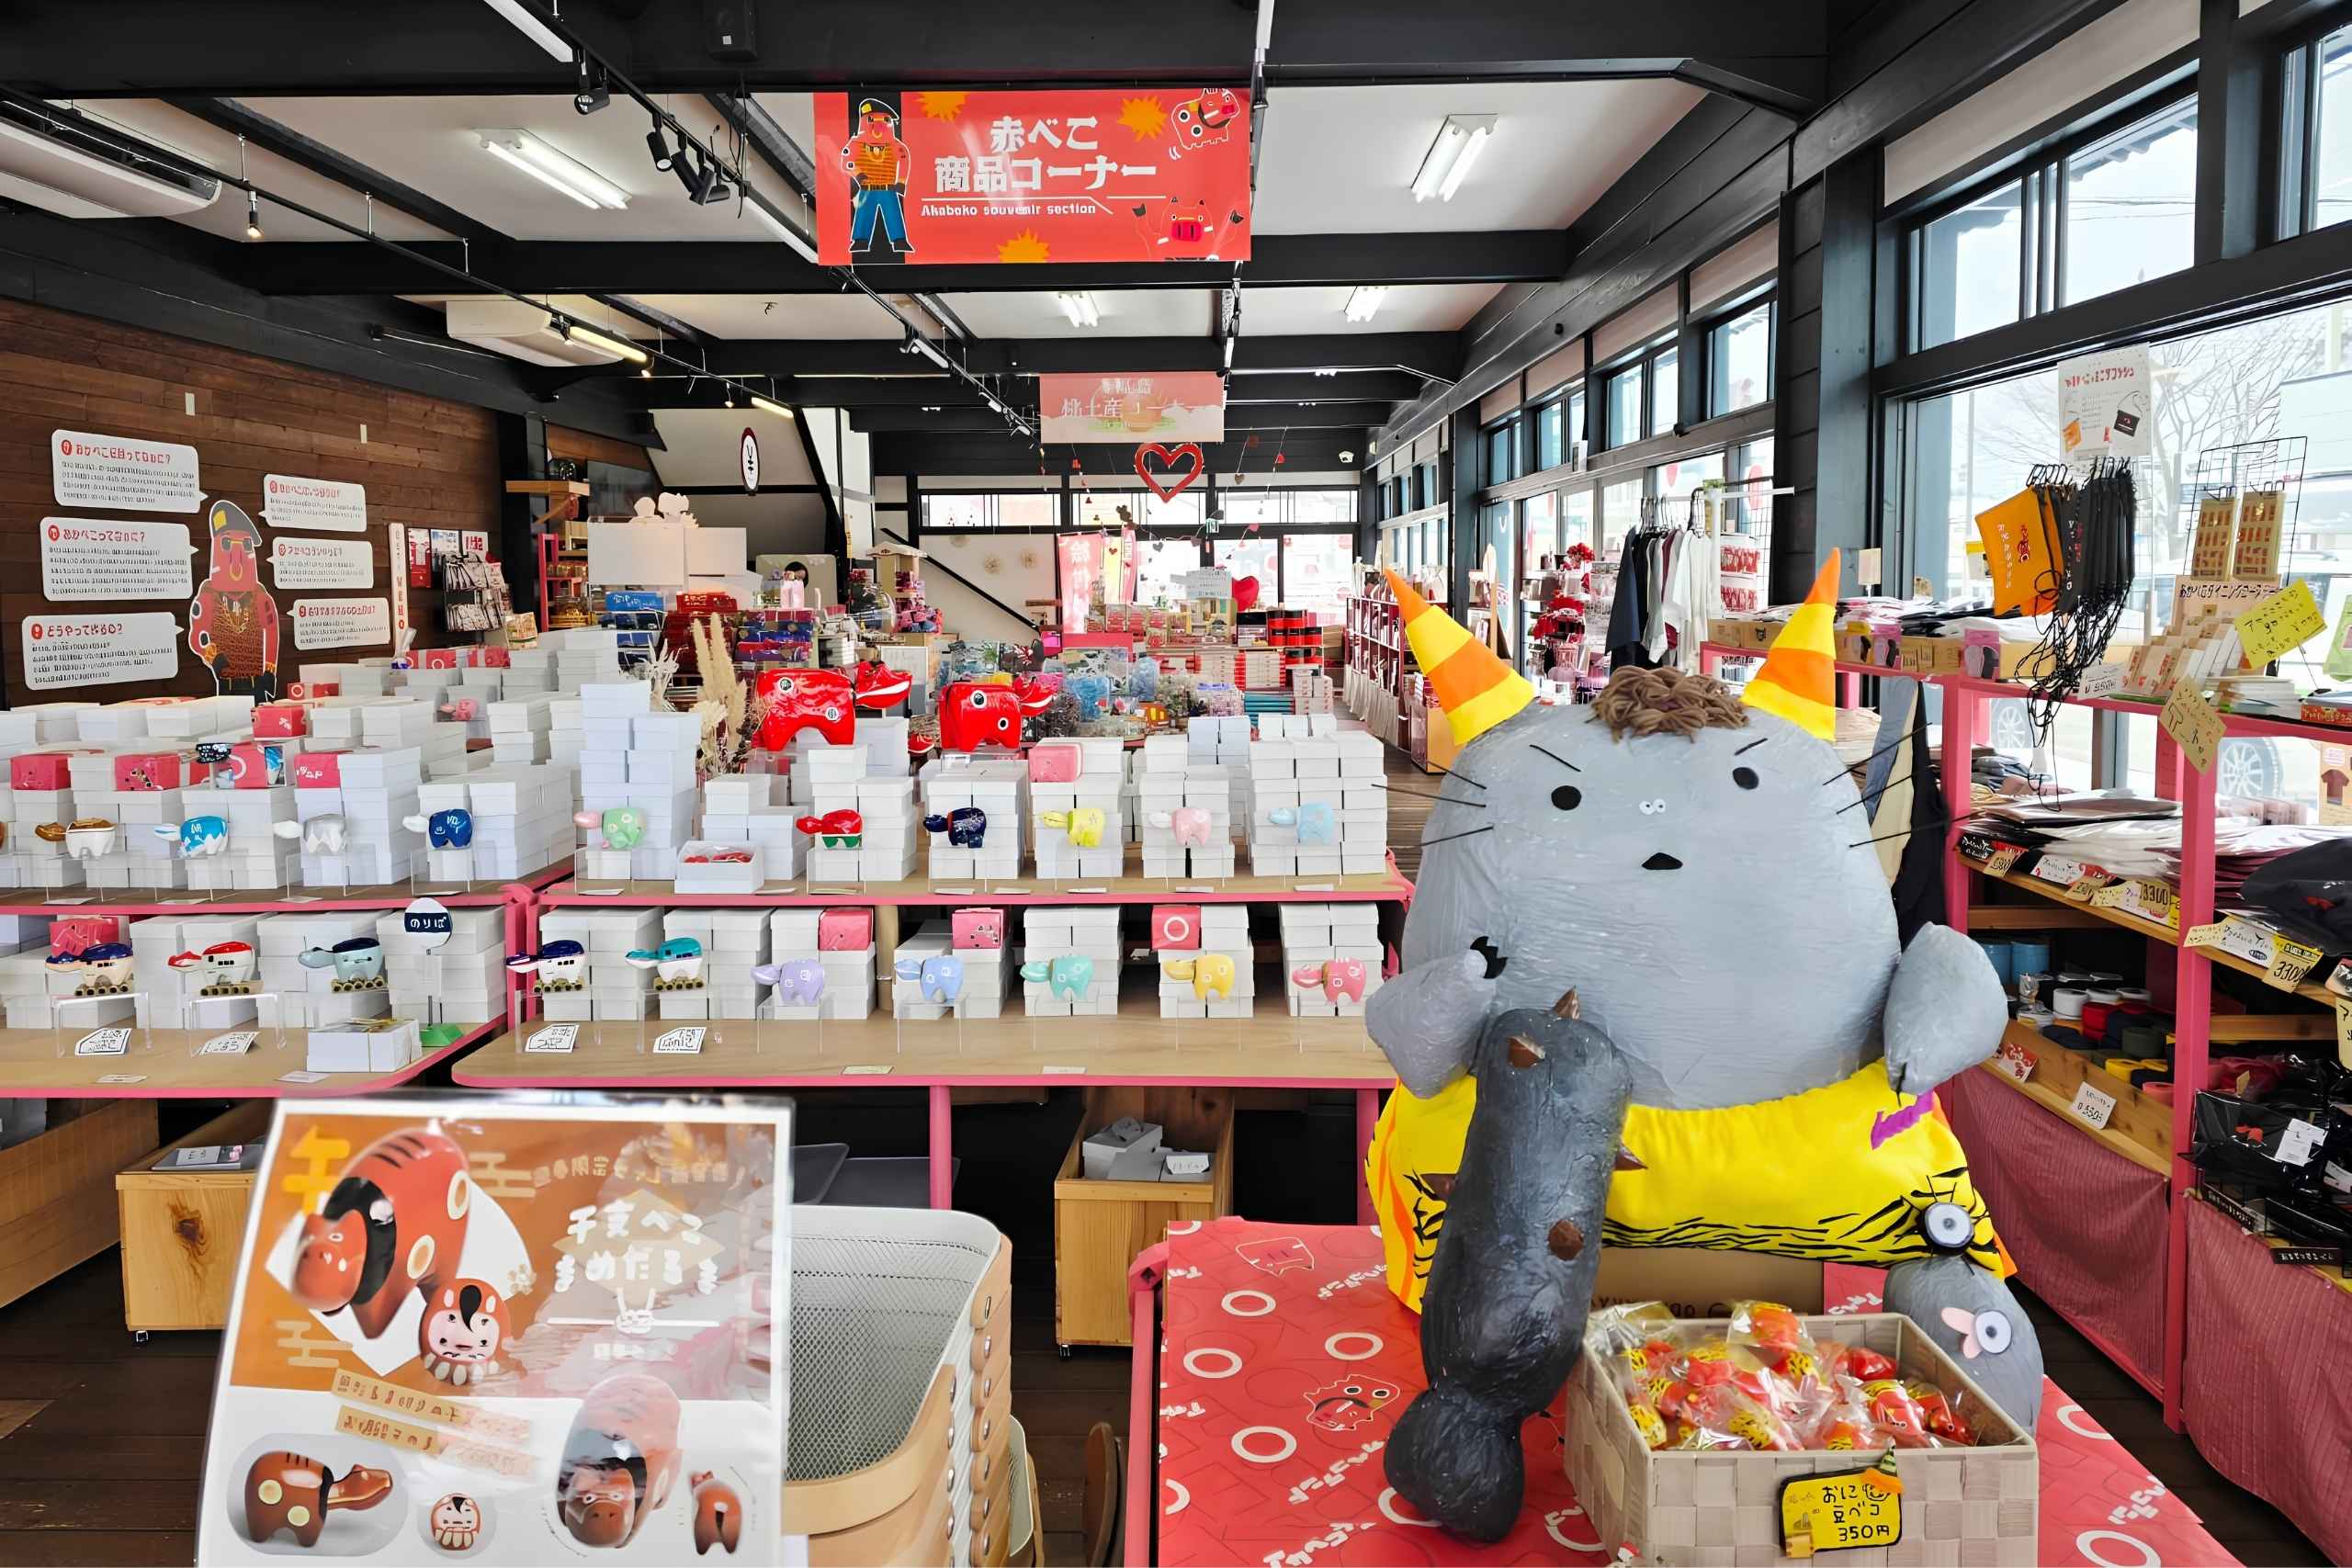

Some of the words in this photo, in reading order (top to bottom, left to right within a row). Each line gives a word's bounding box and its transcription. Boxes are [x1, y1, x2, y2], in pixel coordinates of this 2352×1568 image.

[990, 116, 1100, 154] 赤べこ
[933, 154, 1158, 194] 商品コーナー
[983, 205, 1041, 216] souvenir
[1047, 204, 1097, 215] section
[410, 916, 447, 930] のりば
[1838, 1525, 1890, 1542] 350円
